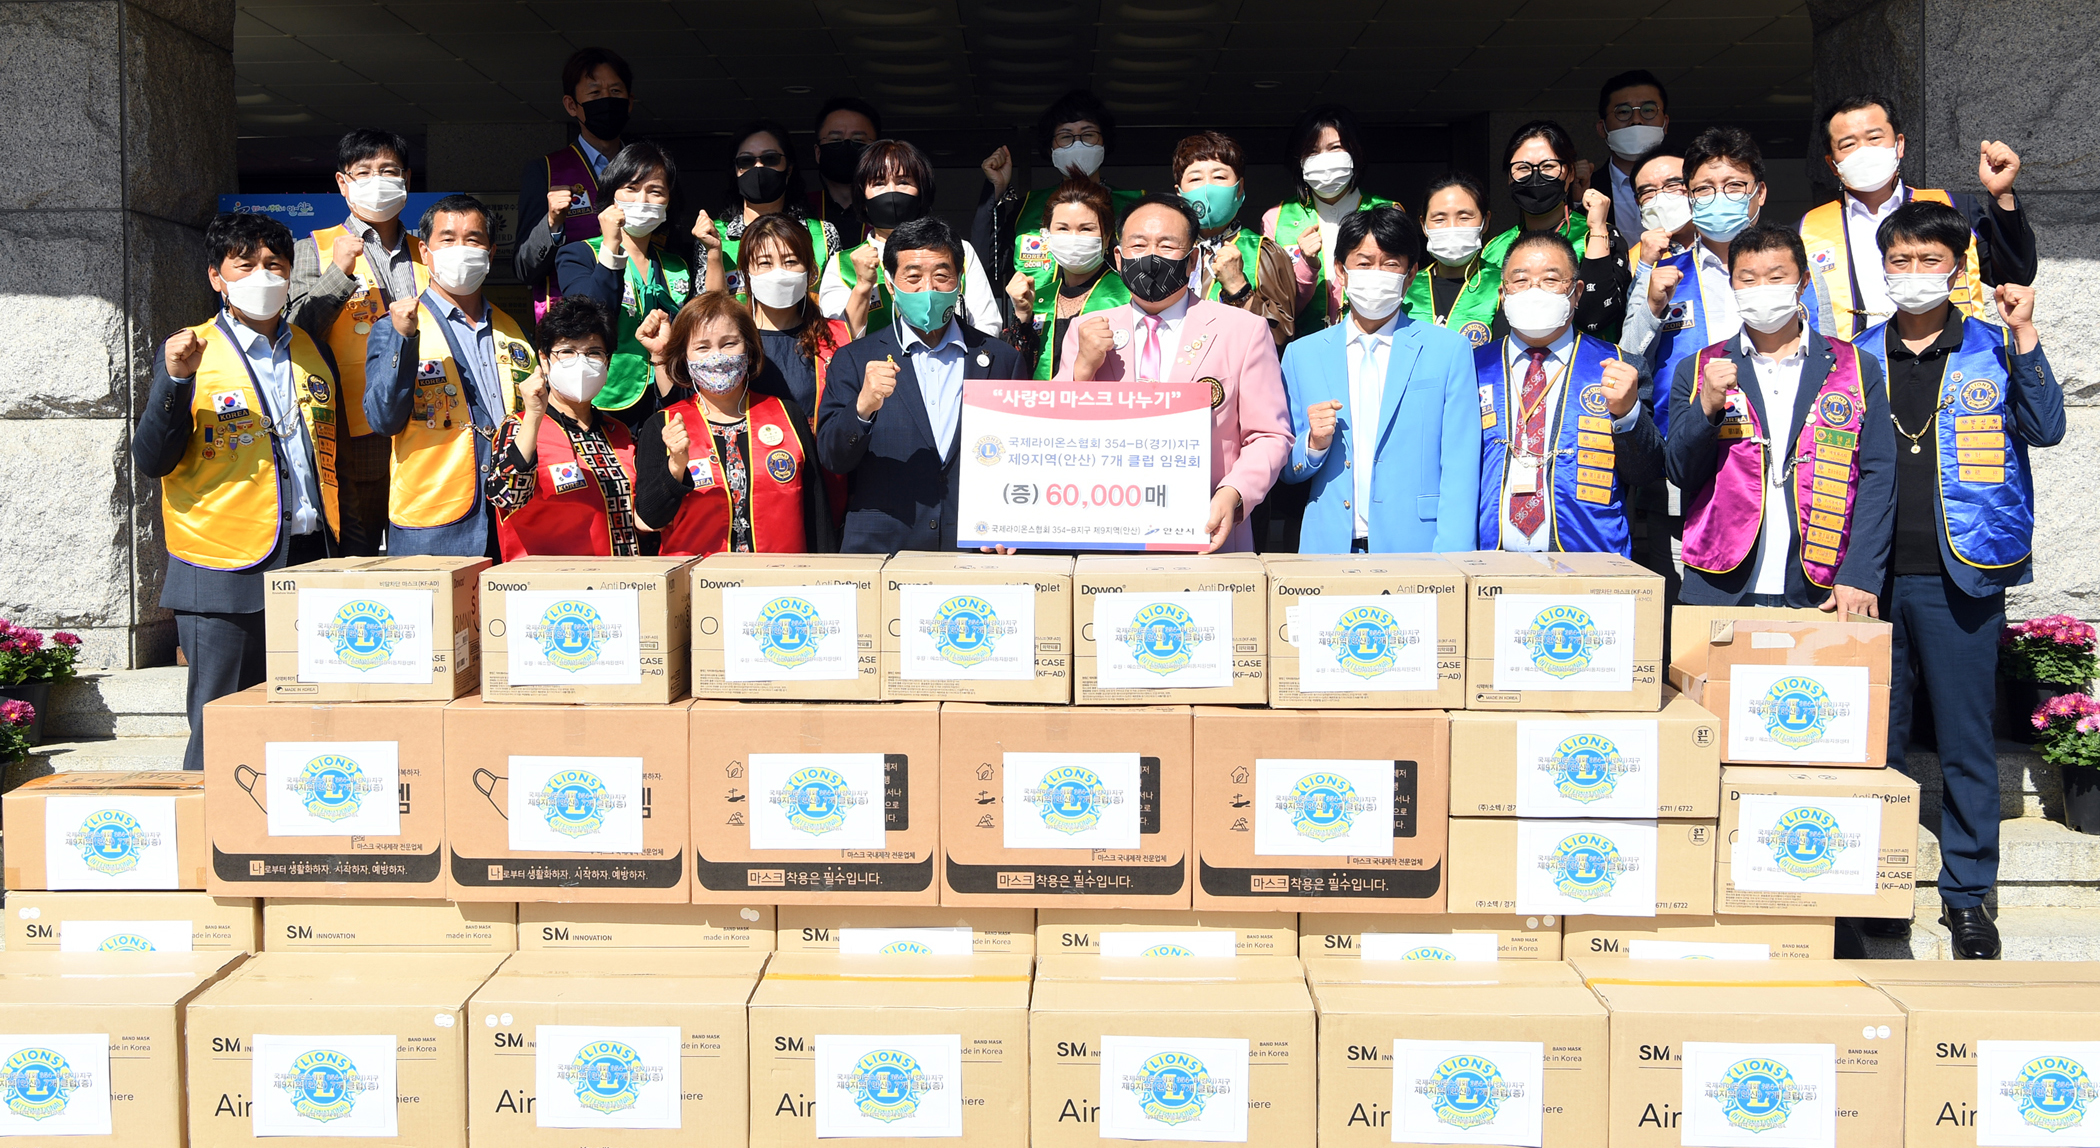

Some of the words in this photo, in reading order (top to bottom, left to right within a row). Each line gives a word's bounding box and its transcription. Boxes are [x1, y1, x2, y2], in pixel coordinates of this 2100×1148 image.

[567, 206, 592, 217] KOREA
[1664, 318, 1693, 330] KOREA
[419, 377, 446, 386] KOREA
[1060, 389, 1113, 409] 마스크
[1976, 389, 1985, 400] L
[219, 409, 249, 421] KOREA
[1832, 402, 1841, 414] L
[1008, 437, 1101, 449] 국제라이온스협회
[1104, 438, 1201, 450] 354-B(경기)지구
[777, 459, 787, 471] L
[1008, 453, 1096, 468] 제9지역(안산)
[1101, 454, 1123, 467] 7개
[1127, 454, 1154, 468] 클럽
[1160, 454, 1201, 468] 임원회
[557, 480, 586, 493] KOREA
[695, 478, 713, 488] REA
[1002, 483, 1039, 505] (증)
[991, 524, 1050, 534] 국제라이온스협회
[1093, 526, 1141, 536] 제9지역(안산)
[343, 602, 387, 618] LIONS
[549, 602, 593, 618] LIONS
[767, 599, 810, 615] LIONS
[944, 598, 987, 614] LIONS
[1140, 605, 1184, 621] LIONS
[1344, 608, 1390, 624] LIONS
[1540, 607, 1586, 624] LIONS
[562, 622, 583, 648] L
[1041, 659, 1065, 667] CASE
[1238, 659, 1262, 667] CASE
[1774, 678, 1820, 695] LIONS
[1564, 735, 1610, 751] LIONS
[311, 756, 354, 771] LIONS
[1575, 757, 1597, 779] L
[554, 772, 598, 787] LIONS
[794, 769, 839, 784] LIONS
[1049, 768, 1094, 783] LIONS
[1301, 774, 1347, 790] LIONS
[89, 811, 133, 826] LIONS
[1785, 809, 1830, 825] LIONS
[357, 843, 374, 851] 마스크
[375, 843, 399, 851] 국내제작
[399, 843, 423, 851] 전문업체
[1564, 834, 1609, 850] LIONS
[750, 872, 783, 885] 마스크
[786, 871, 820, 885] 착용은
[823, 870, 883, 885] 필수입니다.
[999, 874, 1033, 887] 마스크
[1036, 874, 1070, 888] 착용은
[1073, 873, 1134, 889] 필수입니다.
[1888, 871, 1913, 879] CASE
[1253, 877, 1288, 890] 마스크
[1290, 877, 1325, 891] 착용은
[1327, 876, 1389, 891] 필수입니다.
[26, 924, 53, 938] SM
[286, 925, 313, 939] SM
[542, 927, 569, 941] SM
[802, 927, 829, 942] SM
[106, 935, 148, 950] LIONS
[1061, 933, 1089, 947] SM
[1324, 934, 1352, 949] SM
[1590, 938, 1619, 952] SM
[212, 1037, 241, 1052] SM
[494, 1032, 524, 1048] SM
[700, 1042, 721, 1050] Korea
[774, 1036, 804, 1052] SM
[584, 1043, 632, 1059] LIONS
[1056, 1041, 1087, 1057] SM
[1347, 1045, 1378, 1061] SM
[1638, 1045, 1670, 1061] SM
[1935, 1042, 1967, 1058] SM
[12, 1050, 61, 1066] LIONS
[301, 1052, 347, 1068] LIONS
[864, 1052, 912, 1068] LIONS
[1150, 1054, 1198, 1070] LIONS
[1443, 1057, 1493, 1075] LIONS
[1856, 1057, 1879, 1065] Korea
[1733, 1060, 1784, 1077] LIONS
[2029, 1058, 2079, 1075] LIONS
[597, 1062, 619, 1089] L
[495, 1089, 537, 1114] Air
[1747, 1081, 1770, 1107] L
[214, 1093, 253, 1117] Air
[775, 1093, 816, 1117] Air
[1058, 1098, 1100, 1123] Air
[1347, 1102, 1391, 1127] Air
[1638, 1103, 1682, 1128] Air
[1935, 1101, 1978, 1127] Air
